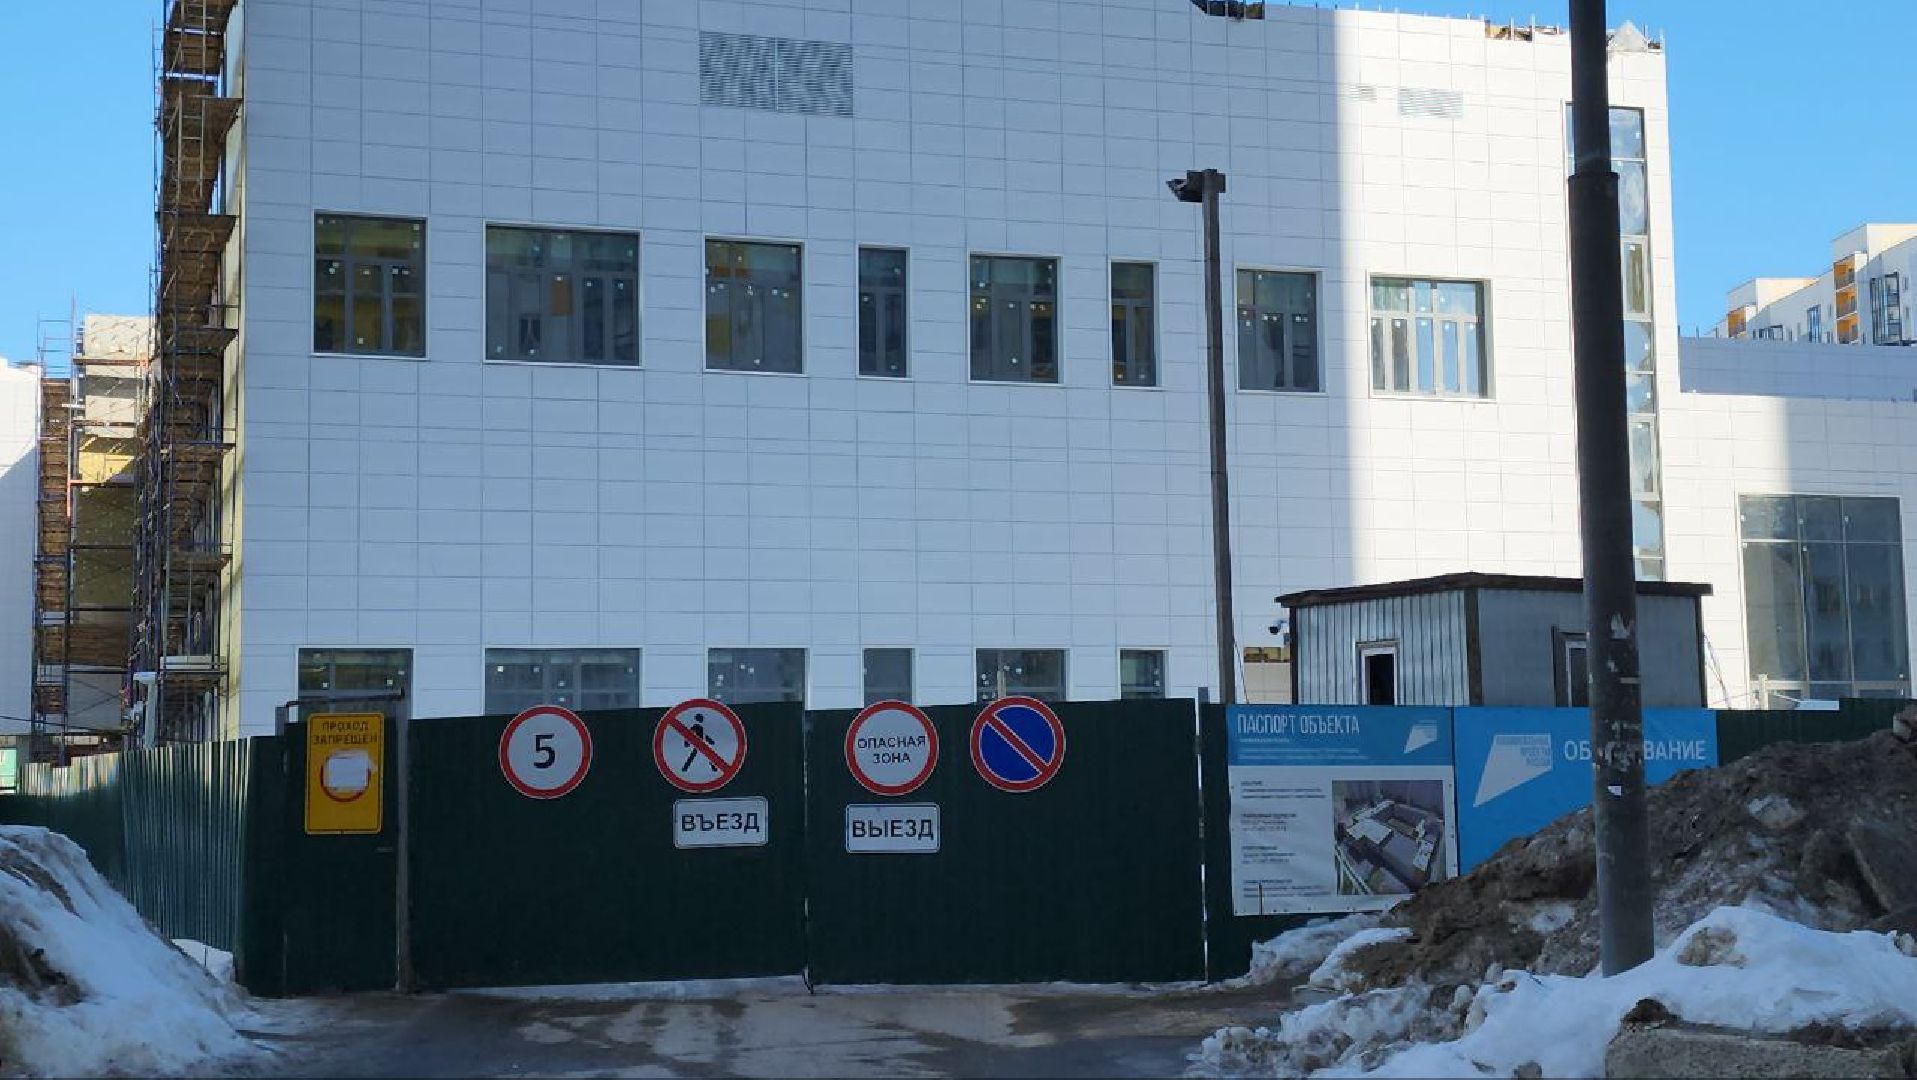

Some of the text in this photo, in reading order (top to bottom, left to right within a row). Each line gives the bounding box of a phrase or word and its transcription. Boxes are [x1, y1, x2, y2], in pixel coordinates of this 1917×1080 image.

[321, 720, 370, 733] ПРОХОД
[1238, 713, 1360, 734] ПАСПОРТ ОБЪЕКТА
[311, 734, 378, 745] ЗАПРЕЩЕН
[857, 735, 926, 749] ОПАСНАЯ
[534, 734, 555, 769] 5
[873, 752, 911, 764] ЗОНА
[1565, 740, 1704, 760] ОБВАНИЕ
[681, 812, 760, 833] ВЪЕЗД
[852, 819, 934, 841] ВЫЕЗД
